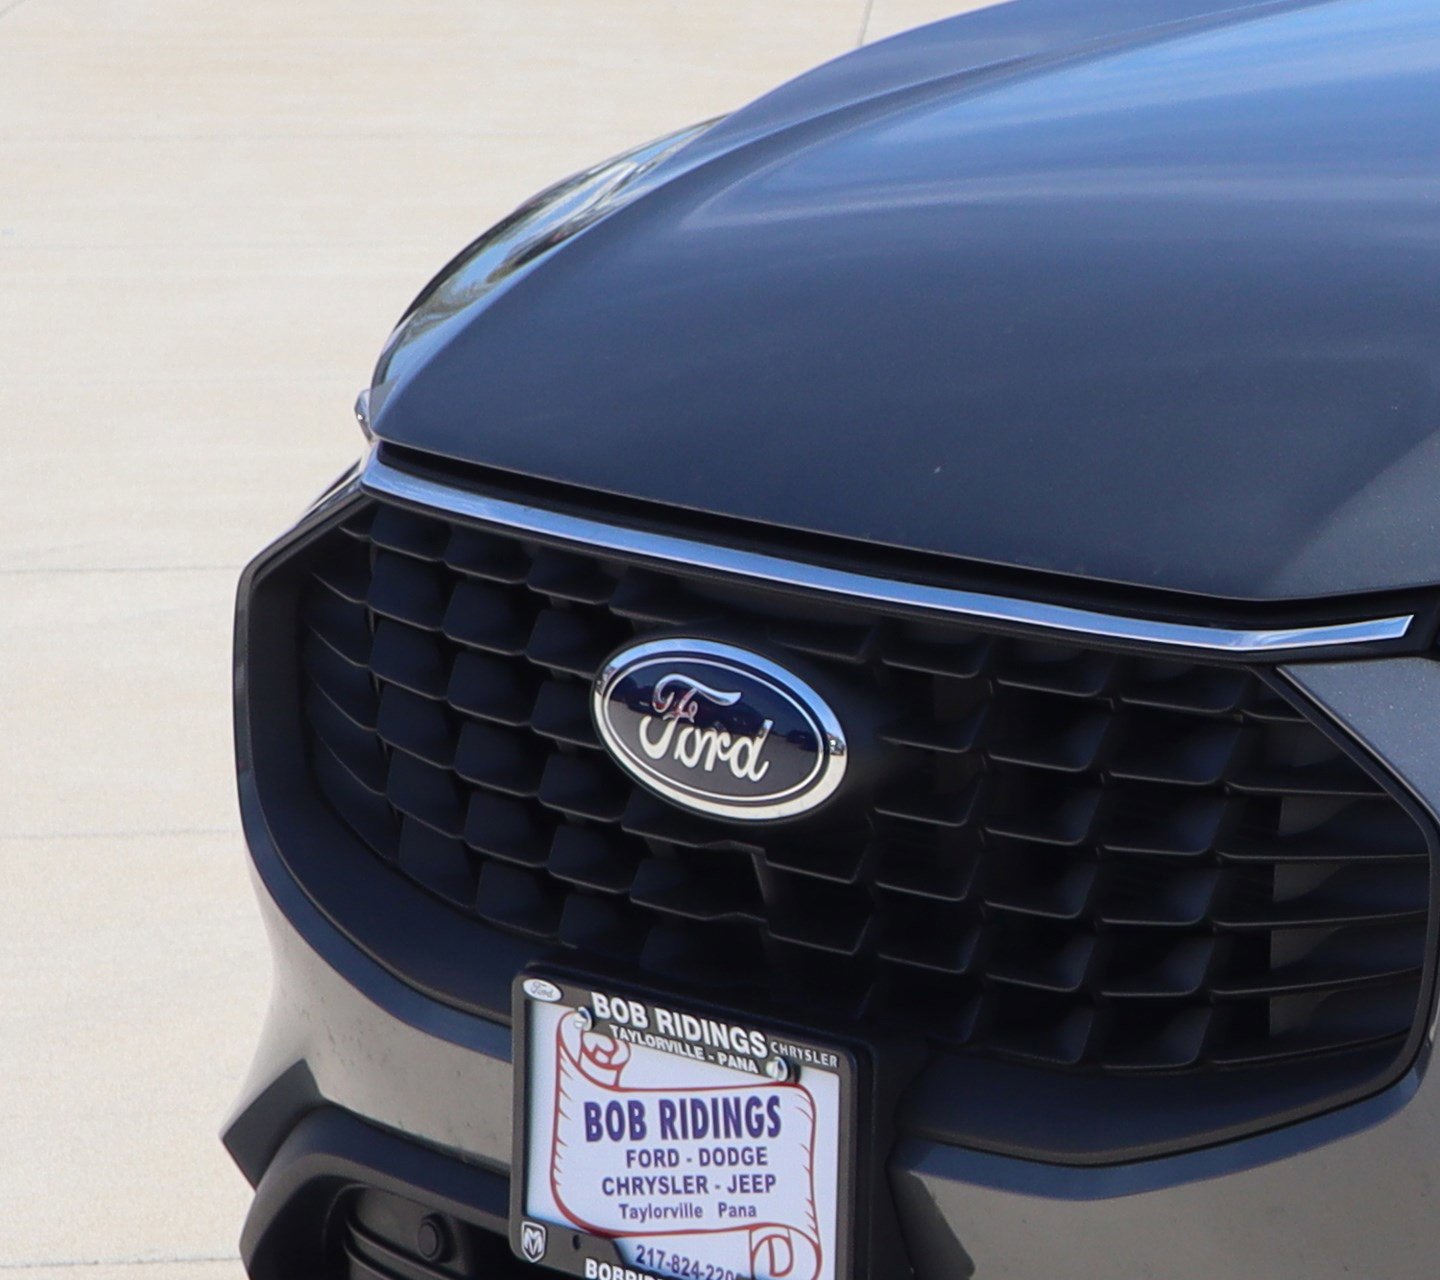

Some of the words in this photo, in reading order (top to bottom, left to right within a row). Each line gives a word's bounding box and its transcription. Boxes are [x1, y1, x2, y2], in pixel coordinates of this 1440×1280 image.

[639, 672, 773, 782] Ford
[591, 991, 649, 1029] BOB
[654, 1005, 768, 1059] RIDINGS
[610, 1024, 704, 1062] TAYLORVILLE
[718, 1053, 759, 1075] PANA
[771, 1042, 838, 1069] CHRYSLER
[584, 1100, 647, 1143] BOB
[660, 1095, 782, 1140] RIDINGS
[626, 1148, 680, 1169] FORD
[699, 1146, 769, 1167] DODGE
[602, 1175, 708, 1197] CHRYSLER
[726, 1174, 777, 1195] JEEP
[619, 1203, 703, 1222] Taylorville
[718, 1202, 757, 1219] Pana
